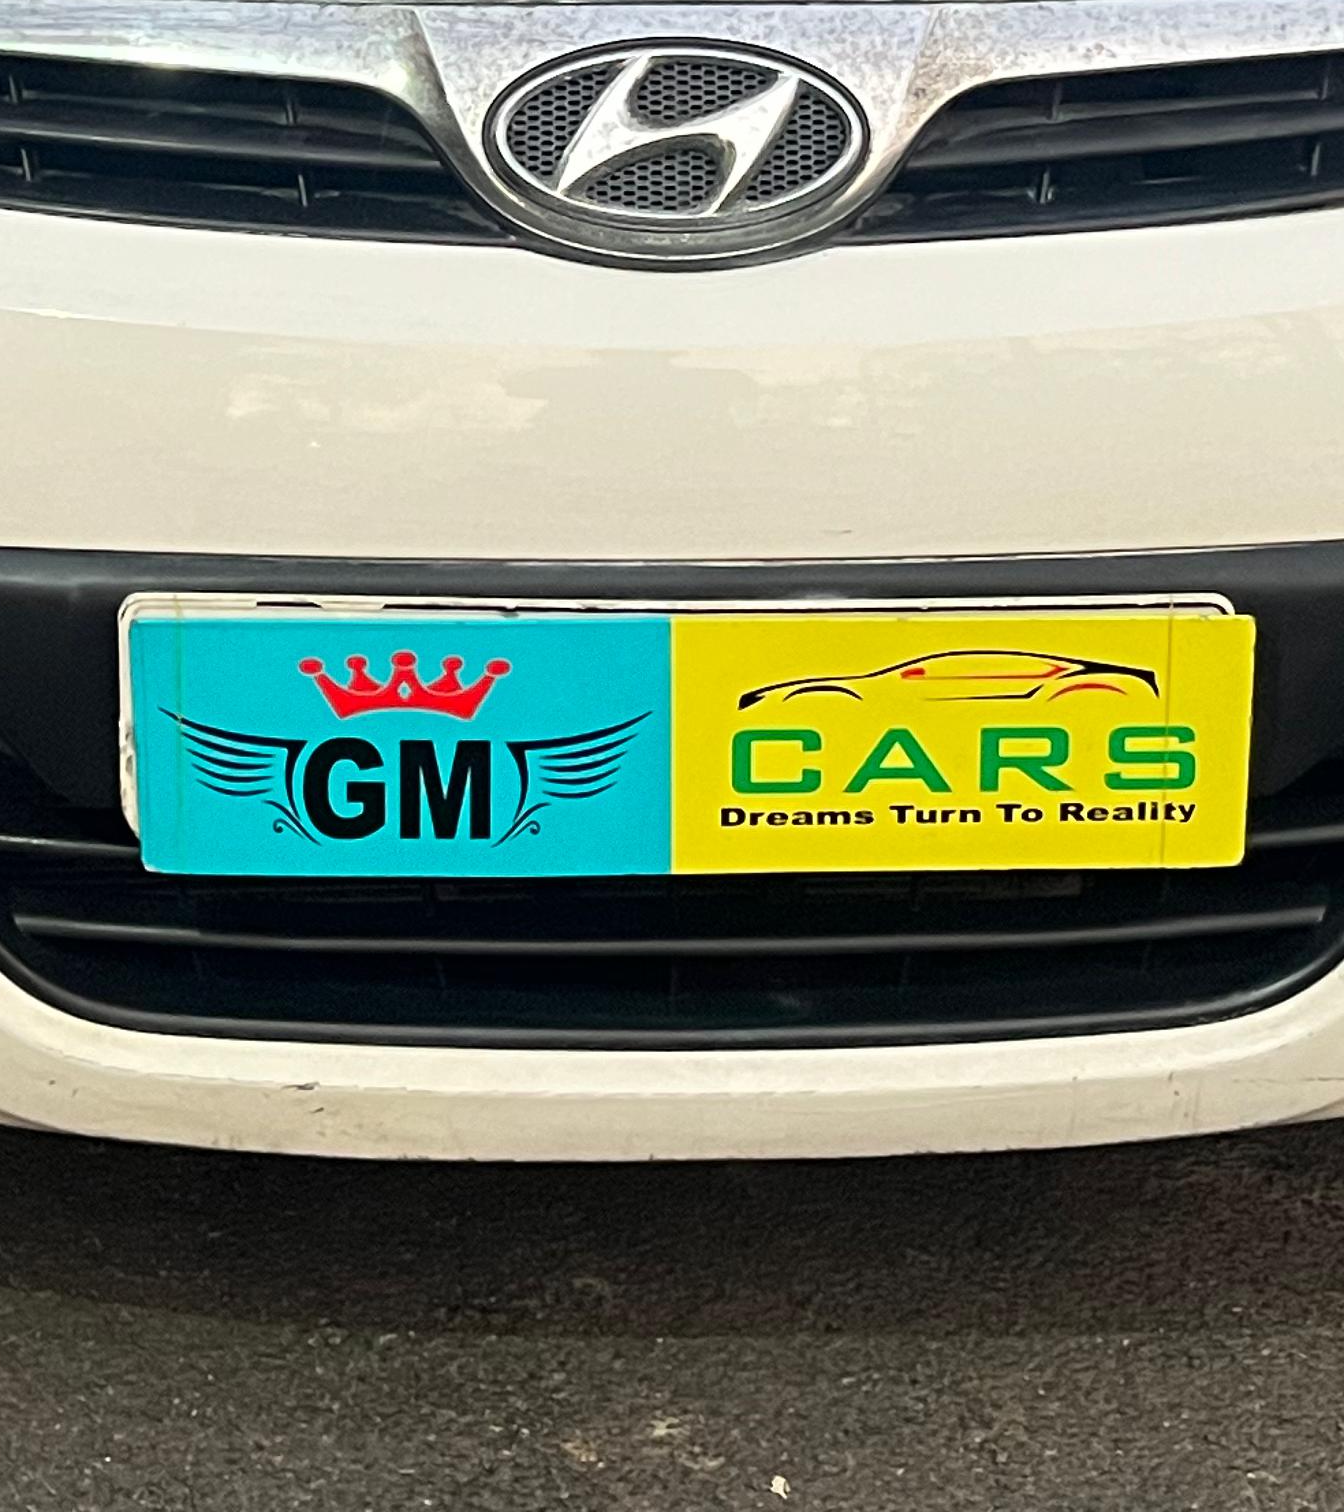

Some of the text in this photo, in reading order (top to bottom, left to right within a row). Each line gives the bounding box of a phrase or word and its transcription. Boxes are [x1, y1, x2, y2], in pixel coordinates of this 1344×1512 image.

[303, 737, 491, 840] GM
[731, 726, 1196, 794] CARS
[720, 801, 1197, 828] Dreams Turn To Reality
